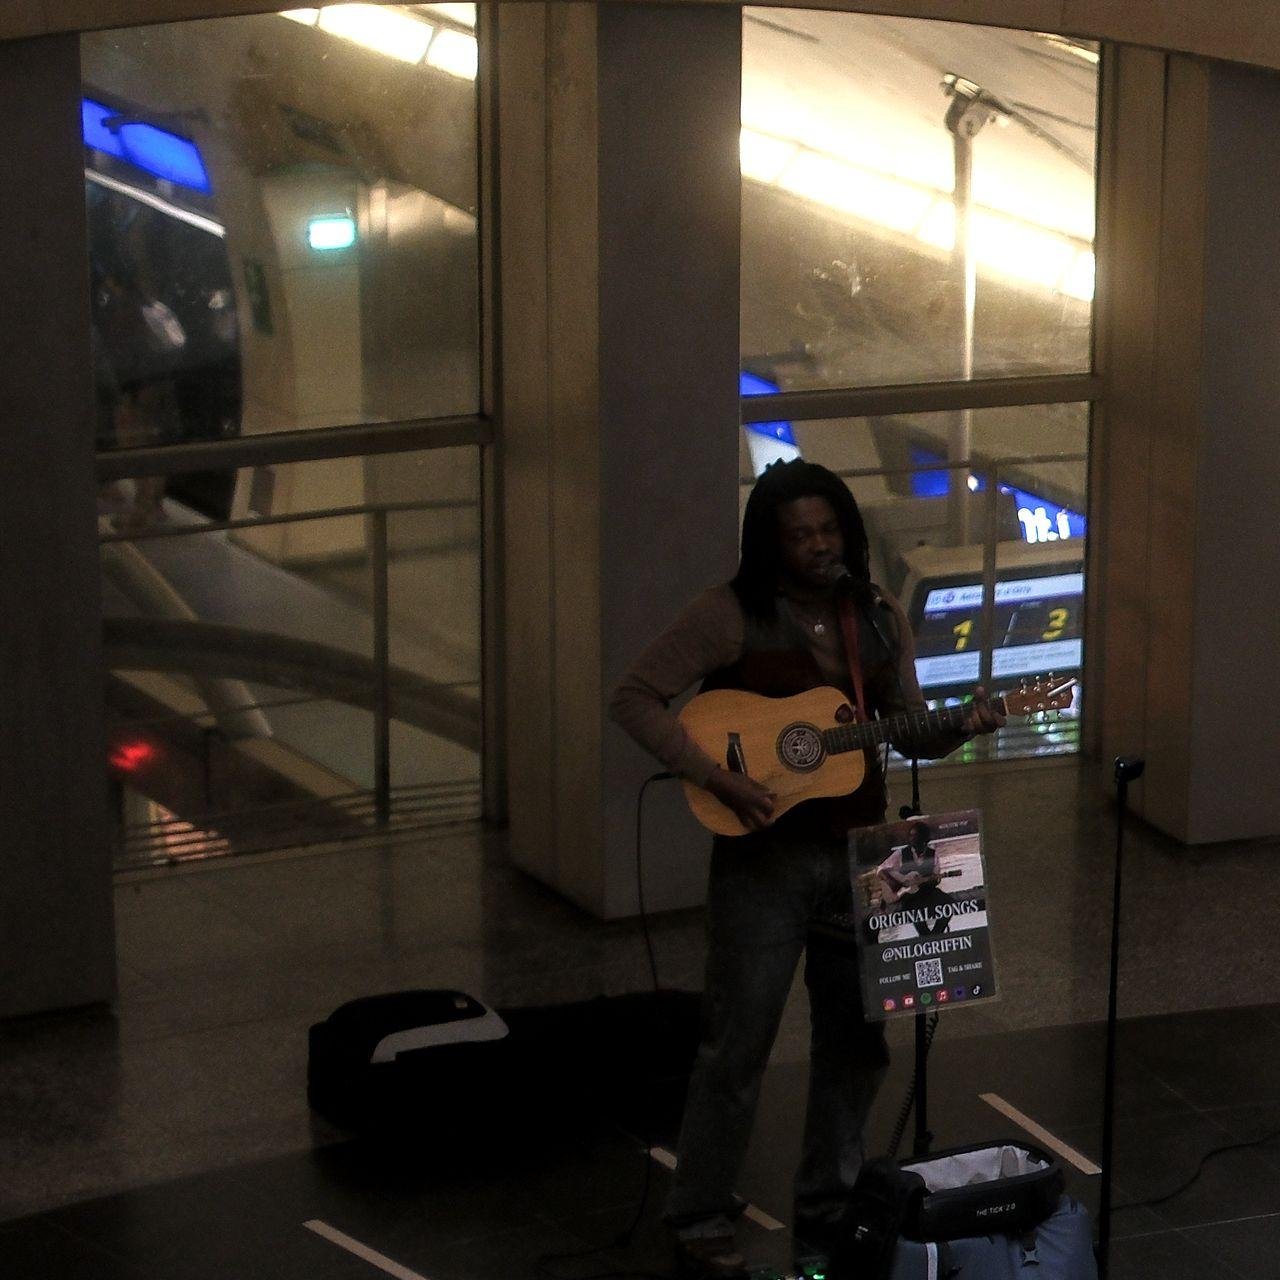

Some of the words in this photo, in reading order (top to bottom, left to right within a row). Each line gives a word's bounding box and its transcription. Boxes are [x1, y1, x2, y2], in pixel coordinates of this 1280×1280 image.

[869, 907, 933, 931] ORIGINAL
[935, 899, 979, 919] SONGS
[882, 935, 973, 962] @NILOGRIFFIN
